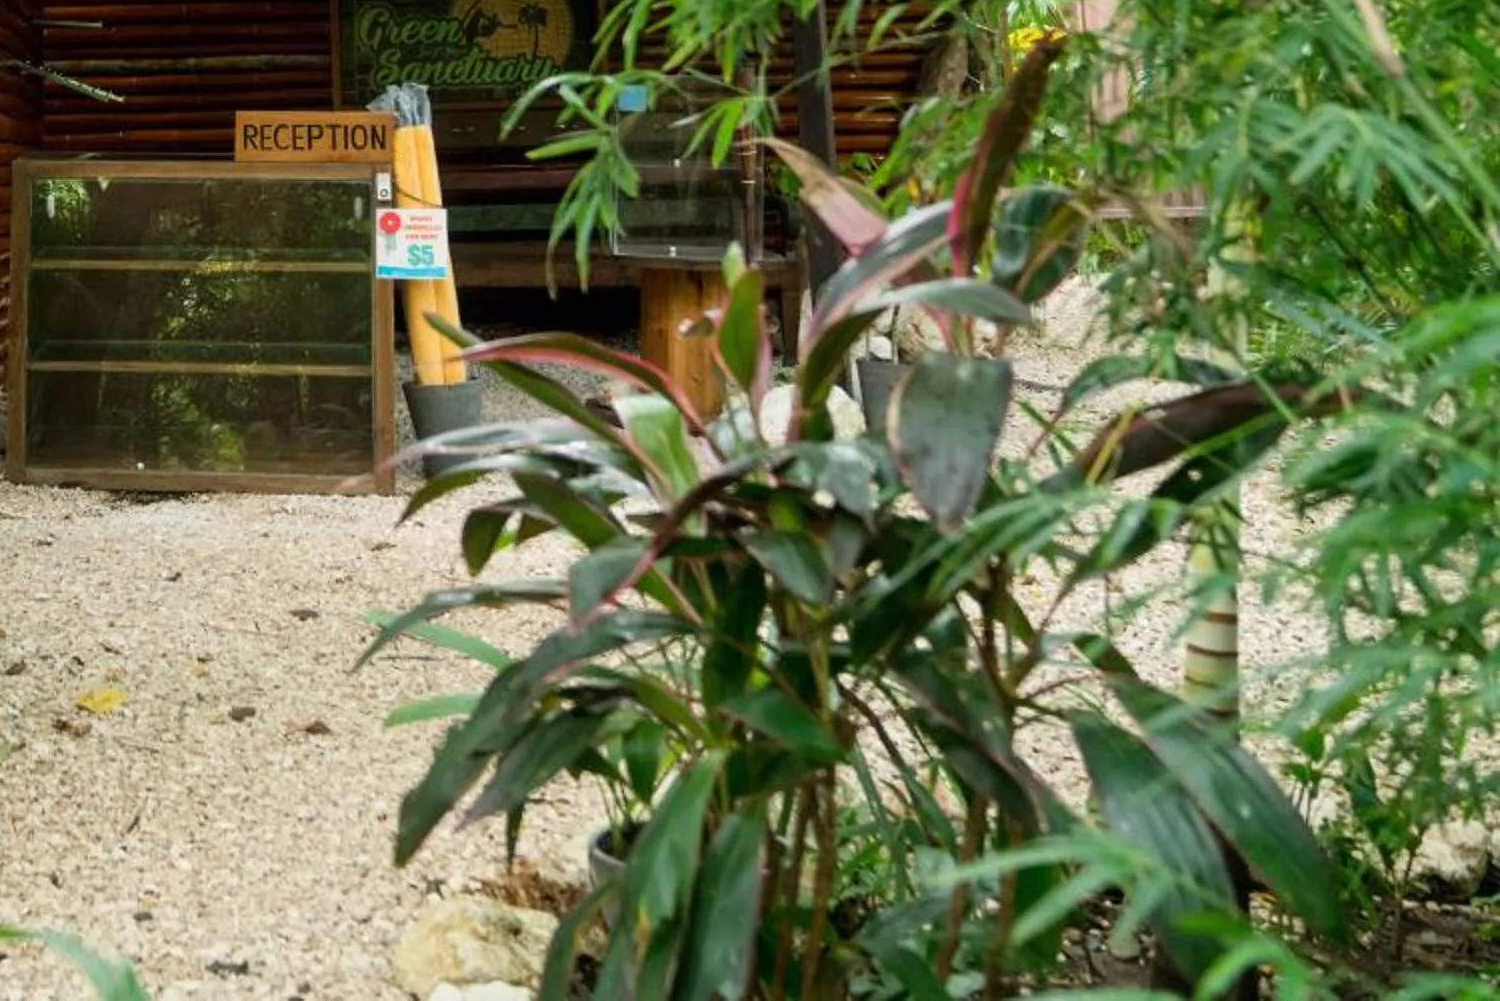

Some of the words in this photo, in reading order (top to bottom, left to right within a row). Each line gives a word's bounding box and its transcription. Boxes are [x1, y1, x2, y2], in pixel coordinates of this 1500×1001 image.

[359, 6, 461, 48] Green
[375, 44, 555, 87] Sanctuary
[243, 124, 387, 150] RECEPTION
[407, 244, 435, 266] $5
